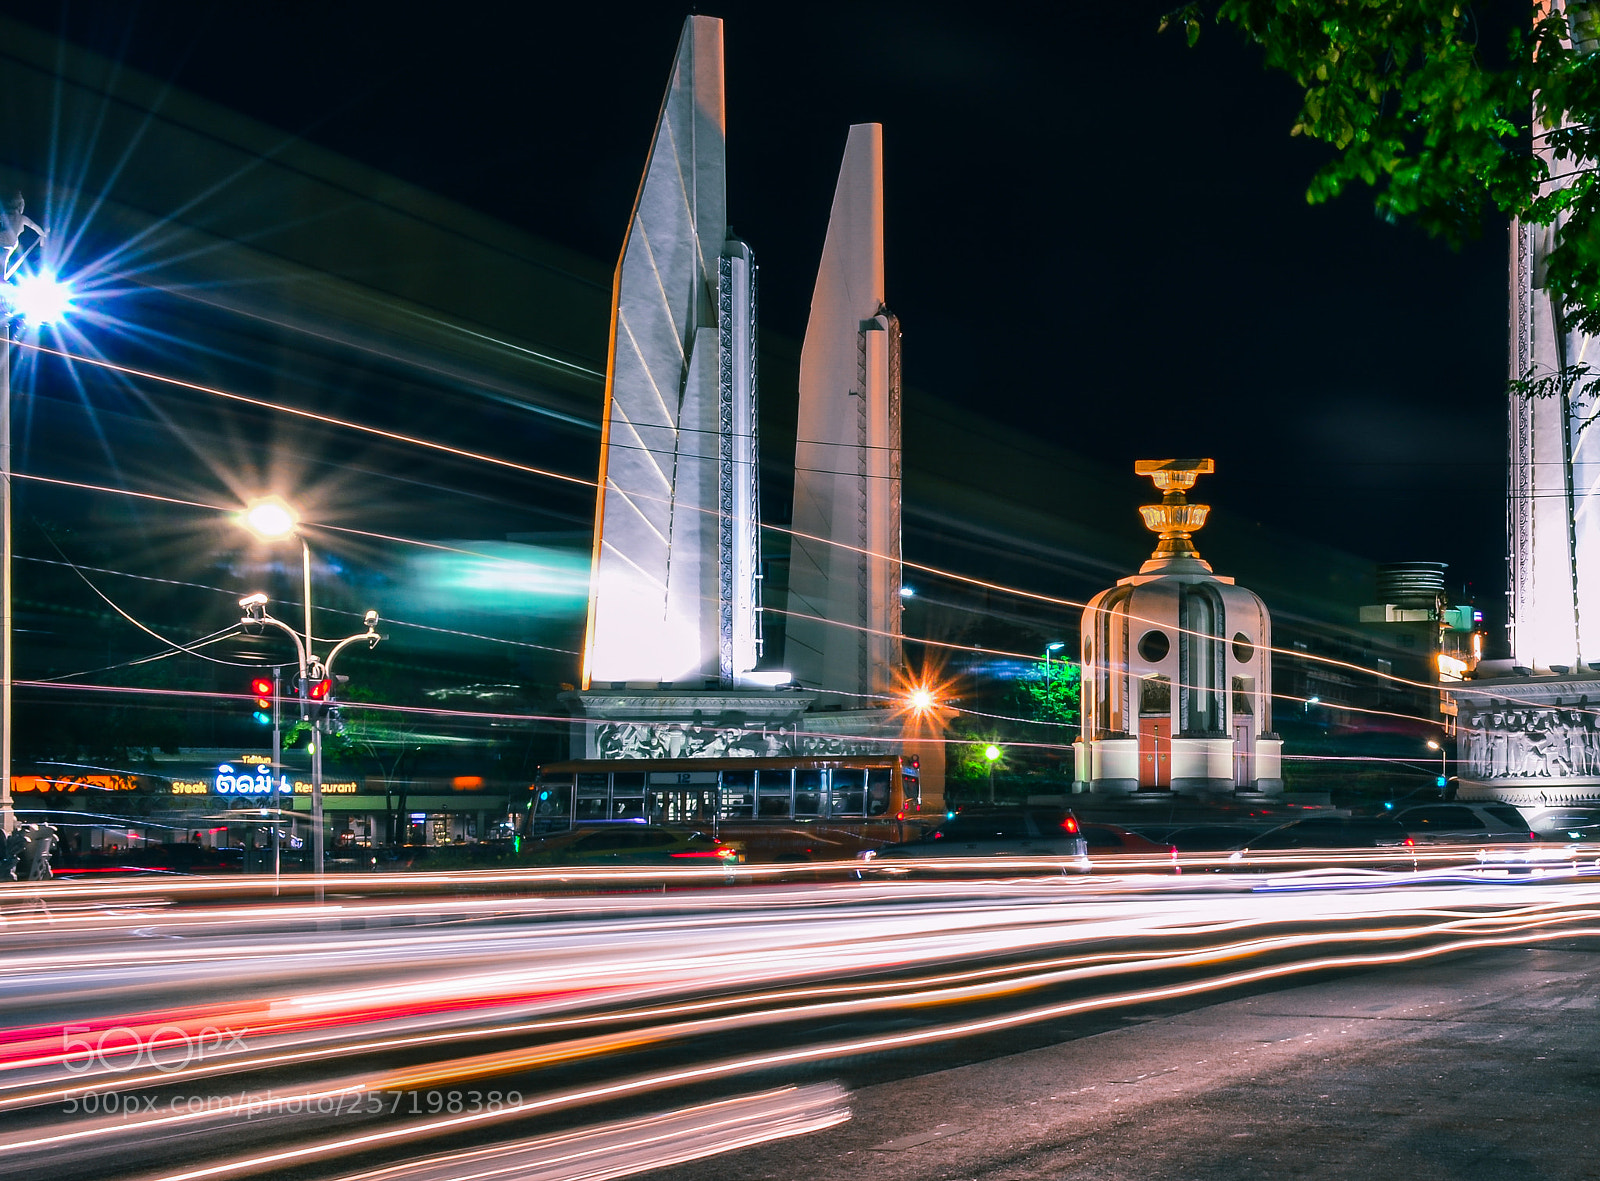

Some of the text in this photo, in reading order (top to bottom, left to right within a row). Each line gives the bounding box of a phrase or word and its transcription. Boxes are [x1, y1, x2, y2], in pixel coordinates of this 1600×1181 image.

[676, 773, 690, 784] 12
[172, 782, 207, 794] Steak
[294, 781, 357, 793] Resaurant
